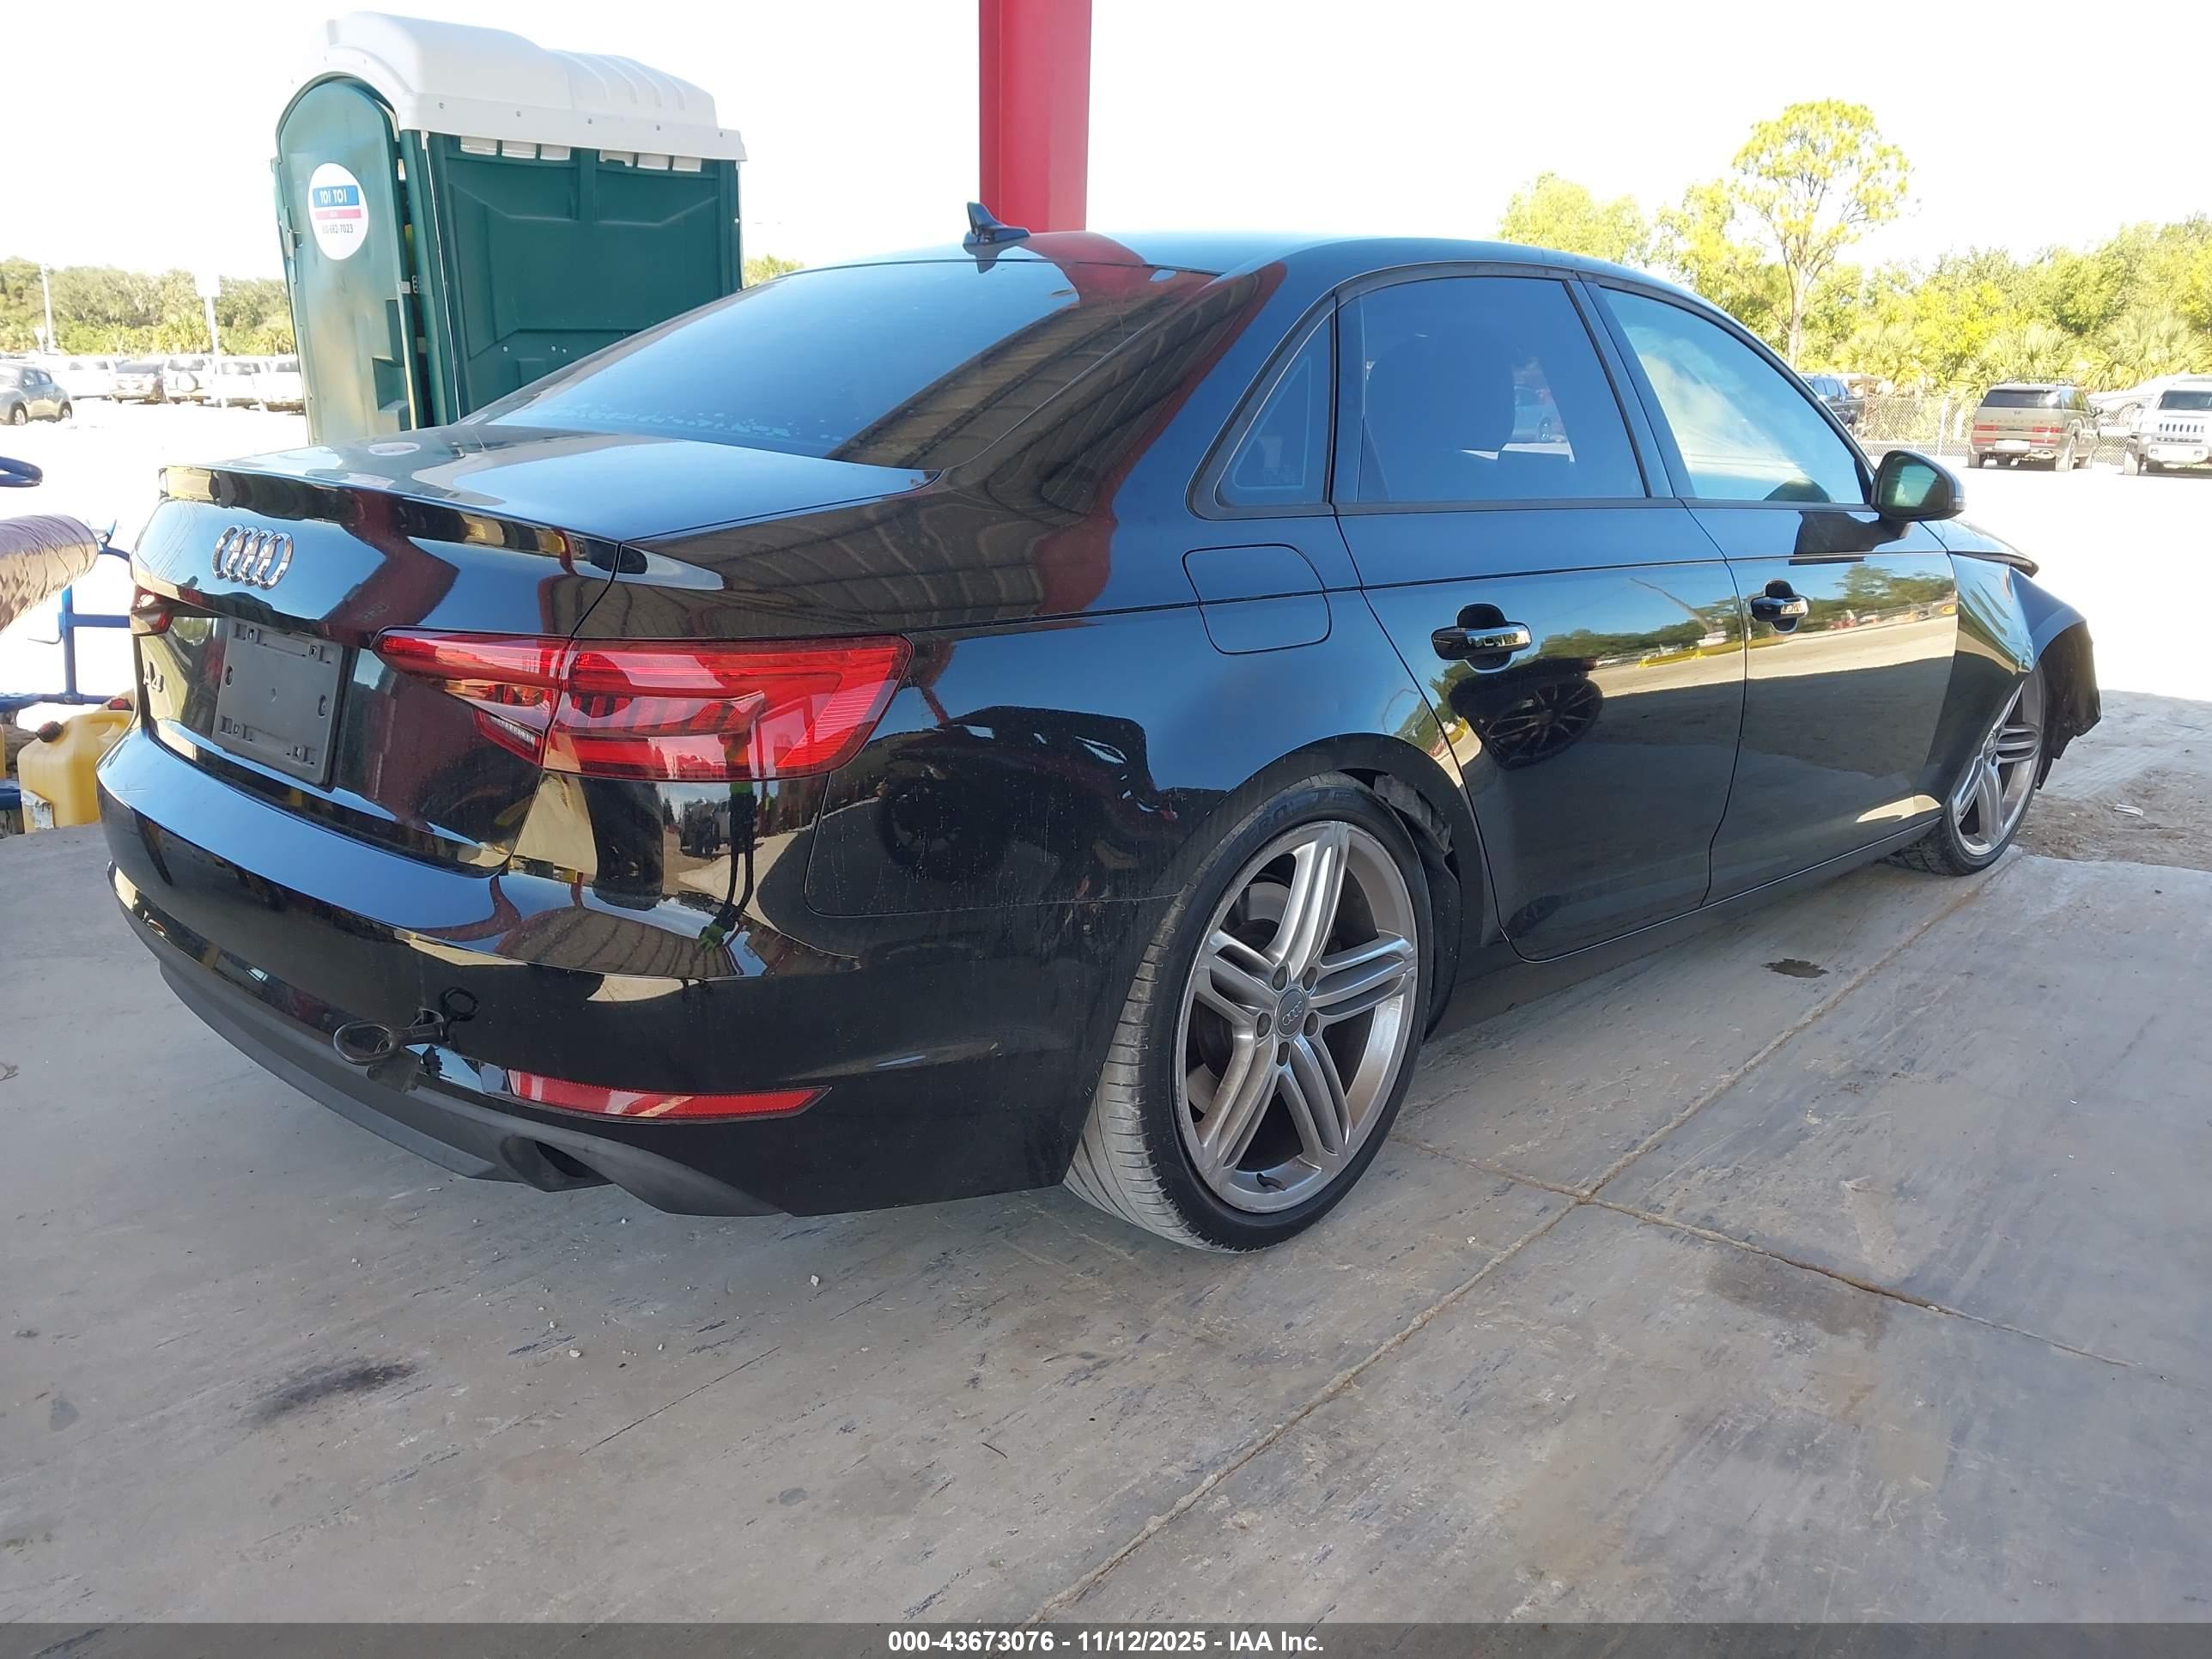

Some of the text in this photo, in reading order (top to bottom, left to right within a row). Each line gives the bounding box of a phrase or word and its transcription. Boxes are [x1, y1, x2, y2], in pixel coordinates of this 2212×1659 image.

[319, 189, 347, 204] TOI TOI
[143, 660, 165, 693] A4
